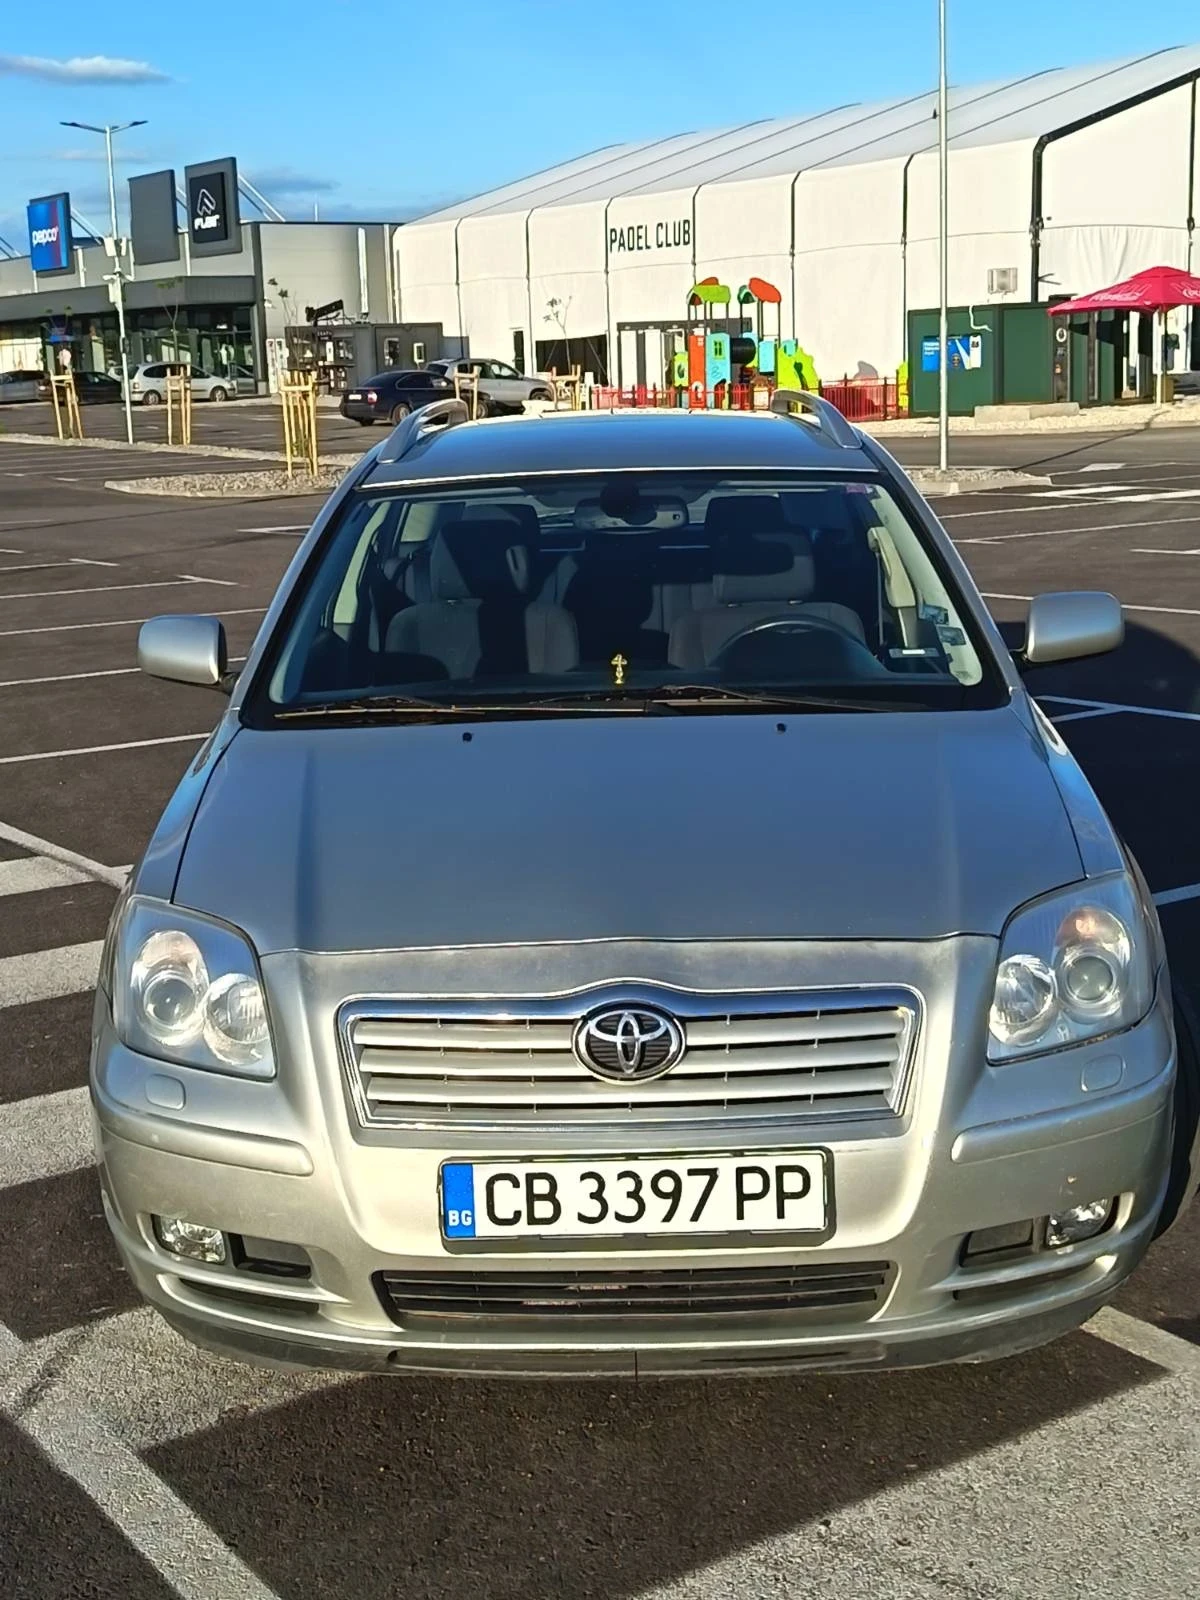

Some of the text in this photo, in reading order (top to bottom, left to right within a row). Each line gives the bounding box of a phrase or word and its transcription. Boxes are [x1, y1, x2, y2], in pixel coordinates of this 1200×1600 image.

[609, 219, 691, 253] PADEL CLUB
[485, 1164, 811, 1227] CB 3397 PP
[448, 1209, 472, 1226] BG
